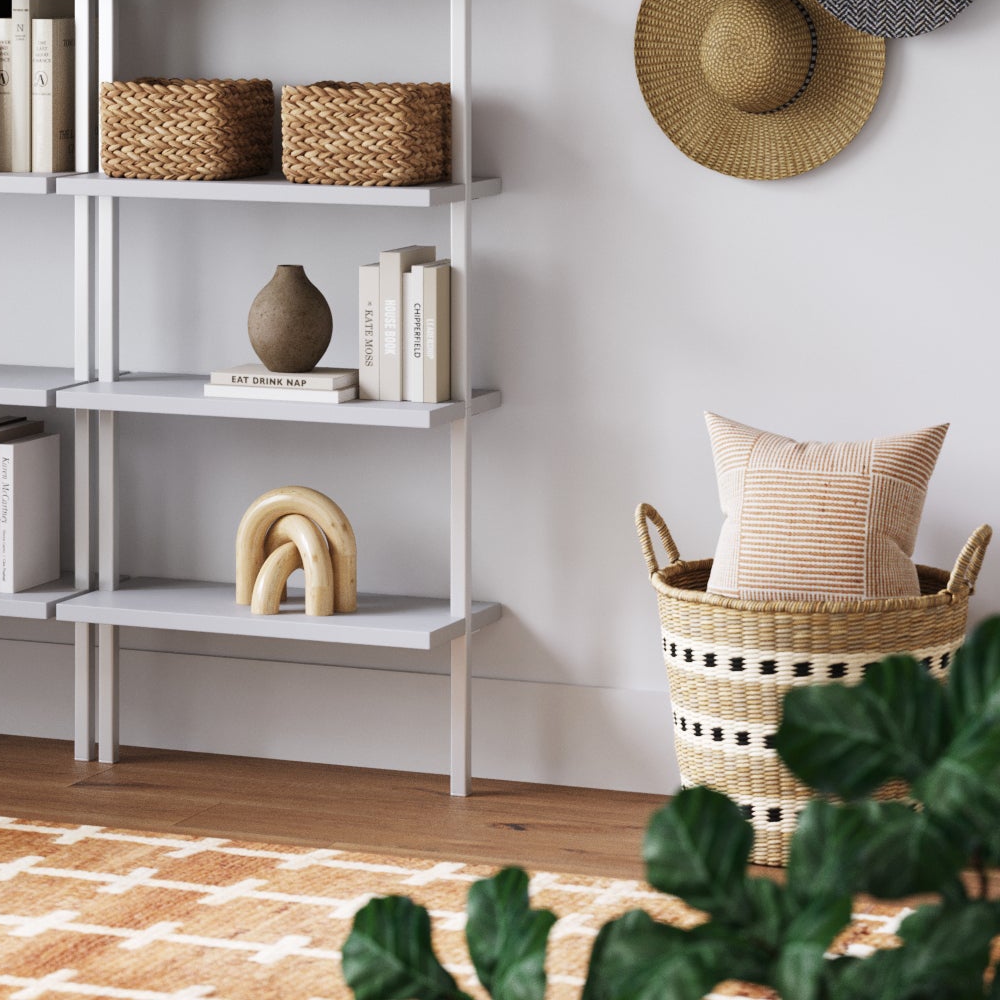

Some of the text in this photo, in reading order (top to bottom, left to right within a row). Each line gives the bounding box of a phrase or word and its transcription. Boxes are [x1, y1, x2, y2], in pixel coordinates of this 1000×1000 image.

[16, 23, 24, 32] N
[365, 309, 373, 367] KATE MOSS
[384, 300, 396, 355] HOUSE BOOK
[231, 375, 307, 387] EAT DRINK NAP
[0, 456, 9, 523] Karen McCartney
